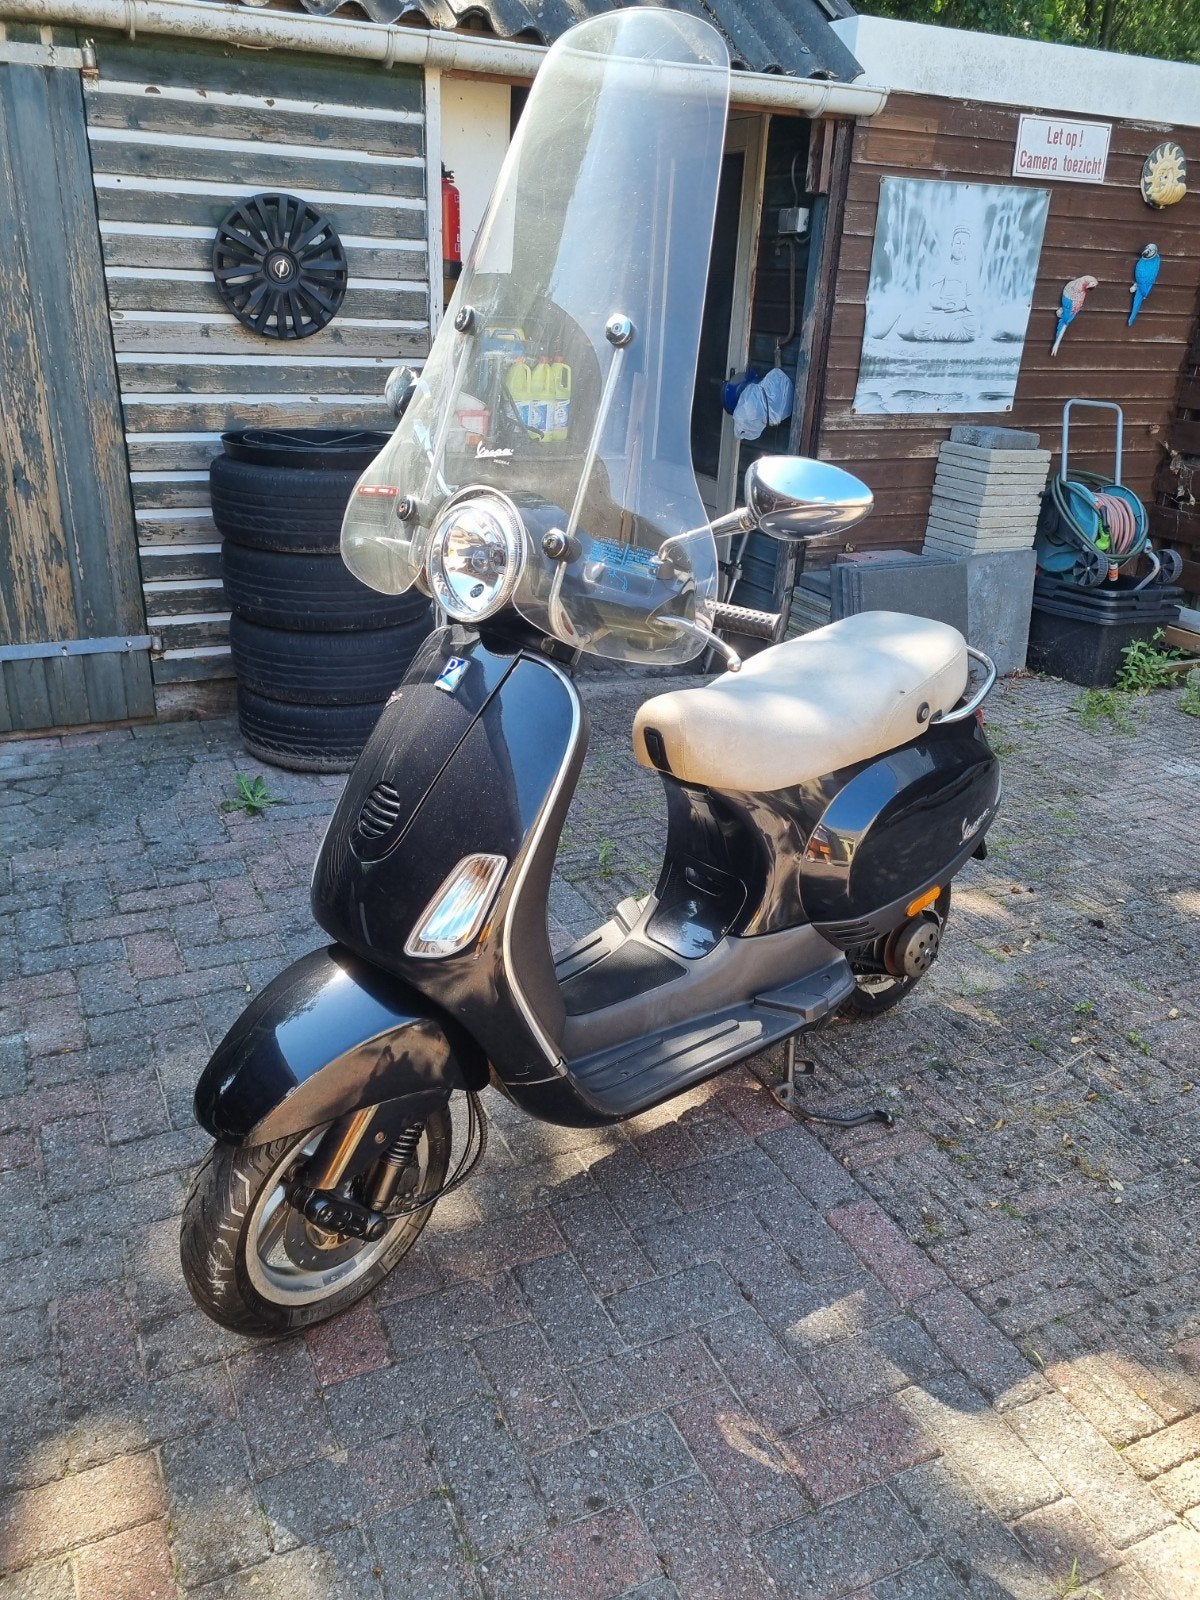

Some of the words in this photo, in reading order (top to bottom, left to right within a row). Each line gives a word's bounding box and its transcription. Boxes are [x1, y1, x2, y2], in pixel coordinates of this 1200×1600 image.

[1046, 126, 1063, 145] Let
[1065, 131, 1078, 150] op
[1019, 150, 1058, 171] Camera
[1063, 155, 1102, 174] toezicht
